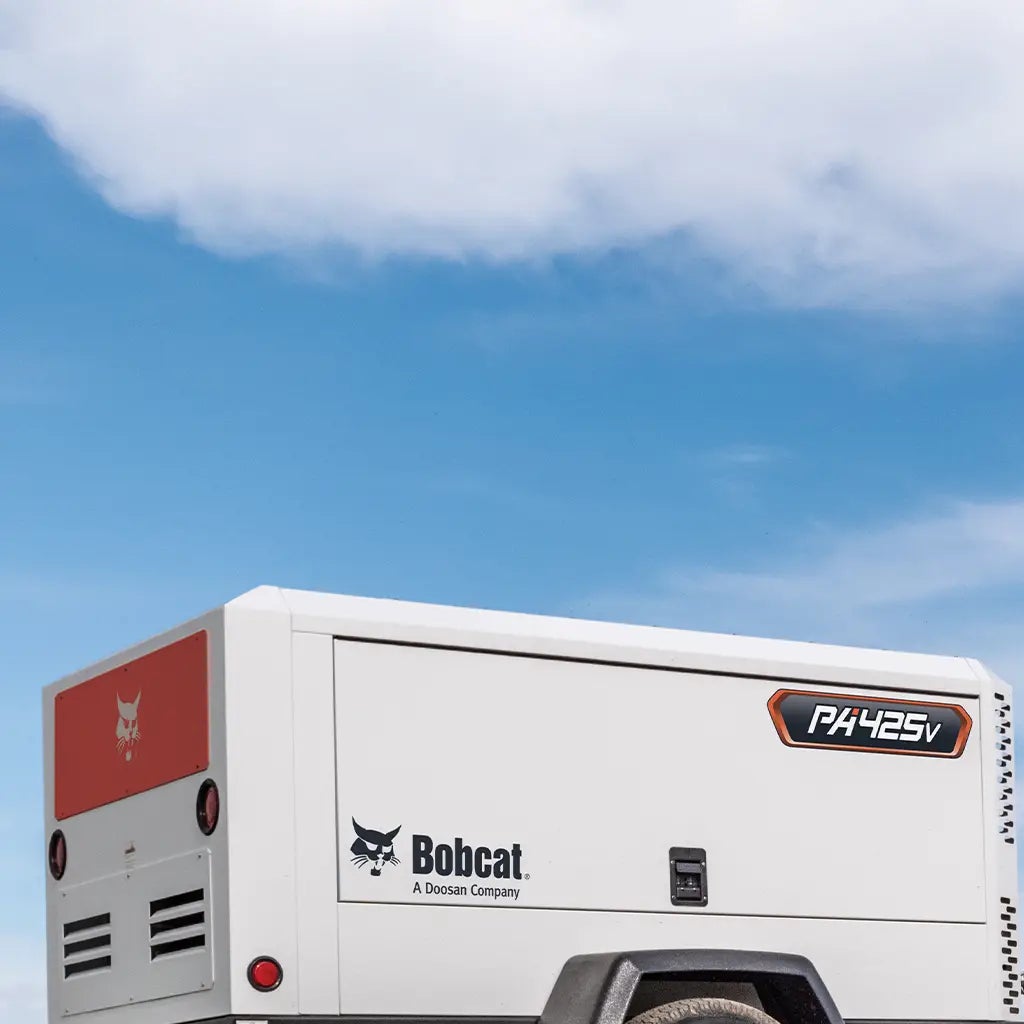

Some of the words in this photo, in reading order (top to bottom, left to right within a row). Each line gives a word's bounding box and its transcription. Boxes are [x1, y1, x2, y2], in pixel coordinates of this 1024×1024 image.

[412, 834, 522, 880] Bobcat
[413, 881, 422, 894] A
[425, 882, 467, 896] Doosan
[470, 884, 520, 900] Company
